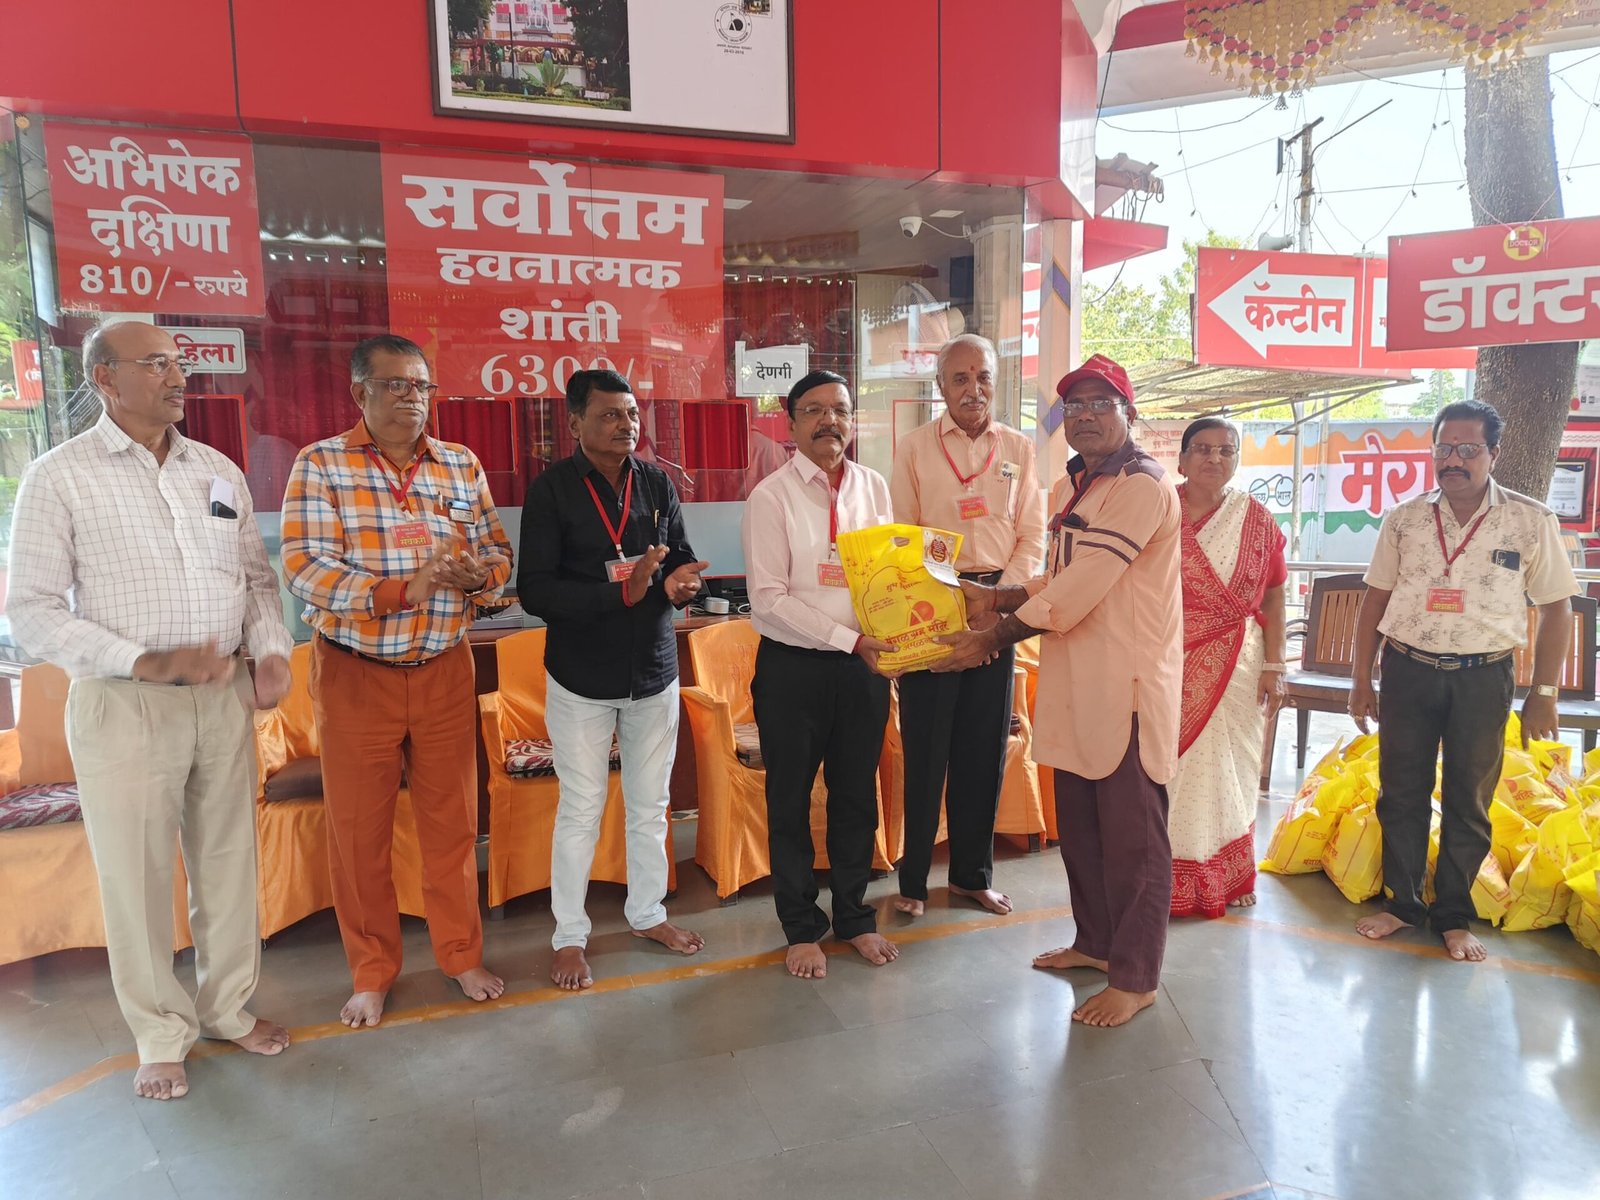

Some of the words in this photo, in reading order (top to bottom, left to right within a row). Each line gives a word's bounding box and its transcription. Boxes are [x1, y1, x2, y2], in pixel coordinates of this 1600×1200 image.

[64, 136, 241, 196] अभिषेक
[87, 194, 231, 258] दक्षिणा
[402, 160, 709, 245] सर्वोत्तम
[437, 247, 682, 289] हवनात्मक
[1509, 239, 1539, 248] DOCTOR
[500, 299, 622, 343] शांती
[1244, 280, 1346, 334] कॅन्टीन
[1420, 256, 1600, 333] डॉक्ट
[755, 361, 792, 380] देणगी
